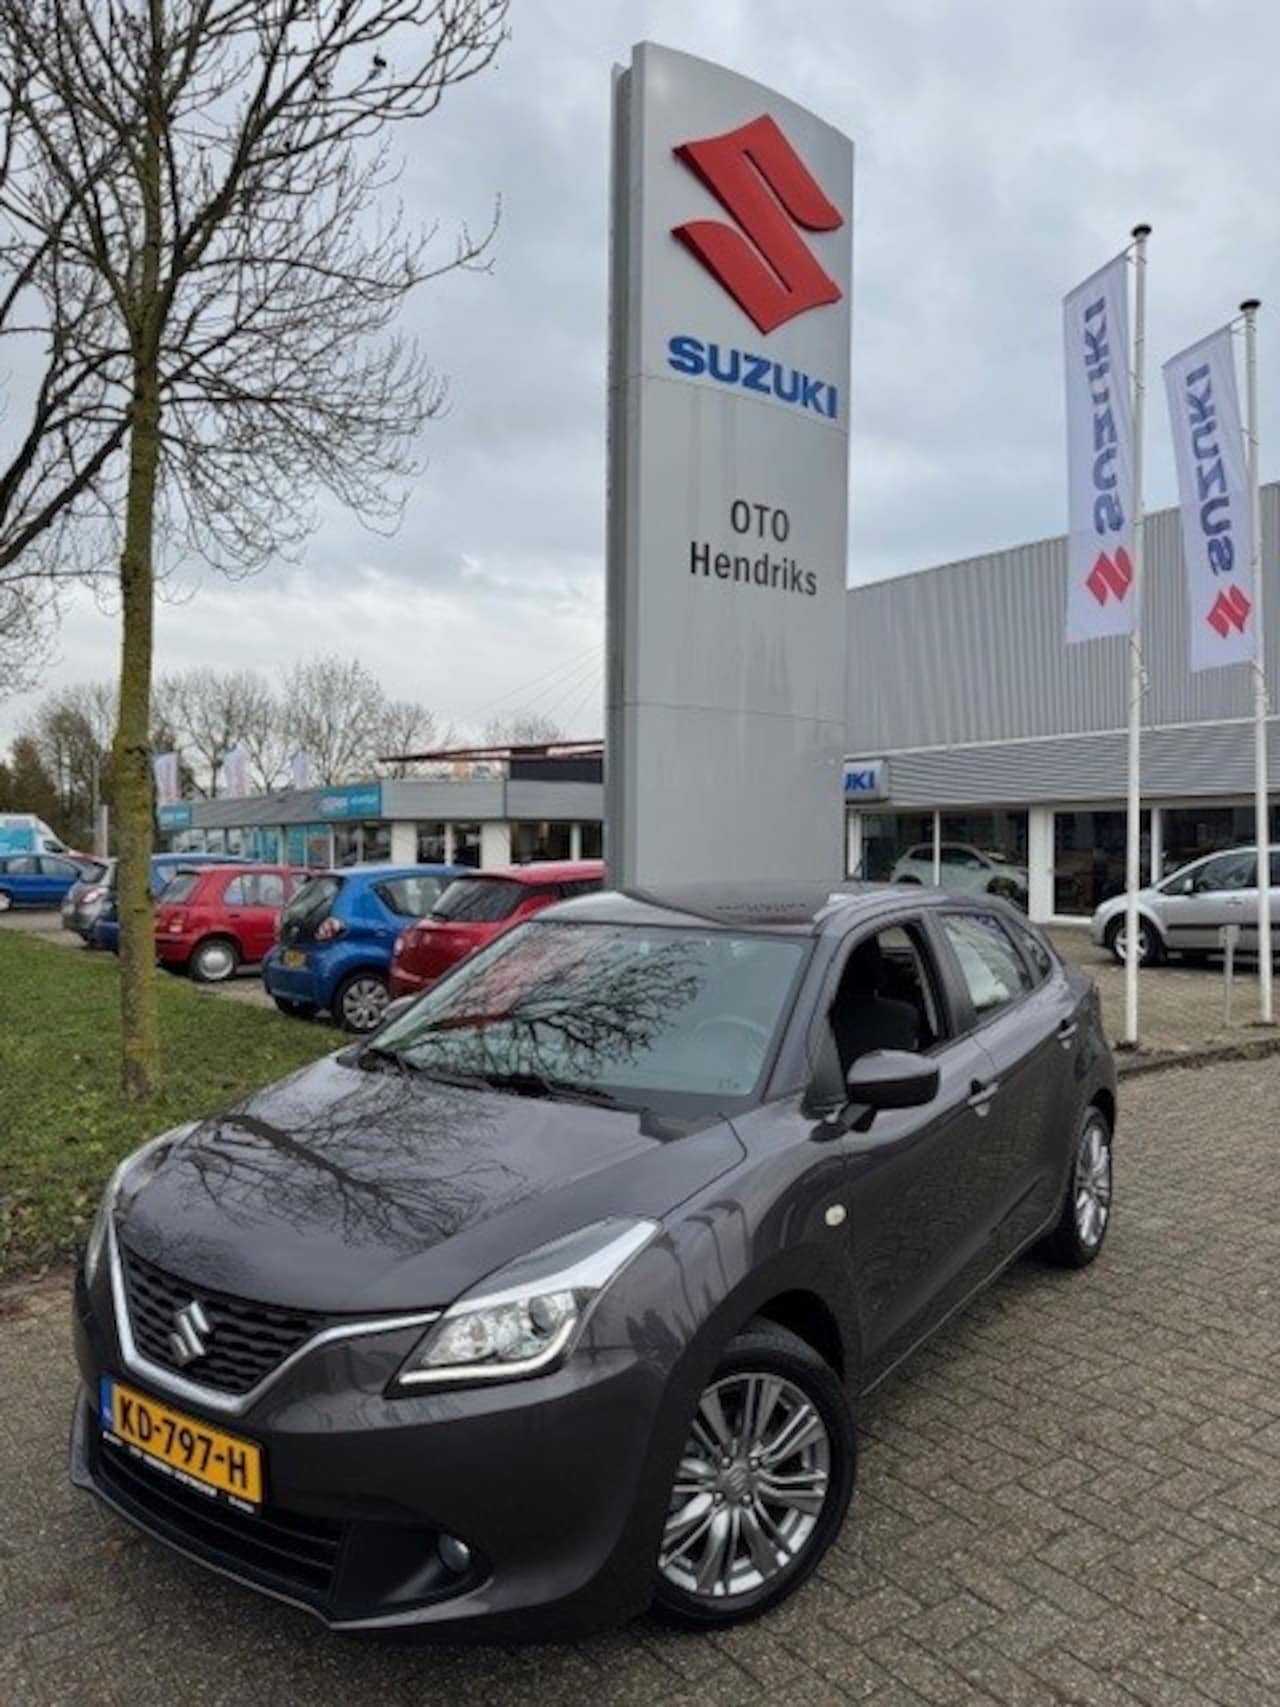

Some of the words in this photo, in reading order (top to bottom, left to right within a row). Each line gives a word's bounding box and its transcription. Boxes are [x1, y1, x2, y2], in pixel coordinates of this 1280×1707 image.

[667, 334, 838, 419] SUZUKI
[730, 499, 790, 543] OTO
[690, 541, 818, 597] Hendriks
[119, 1395, 249, 1490] KD-797-H
